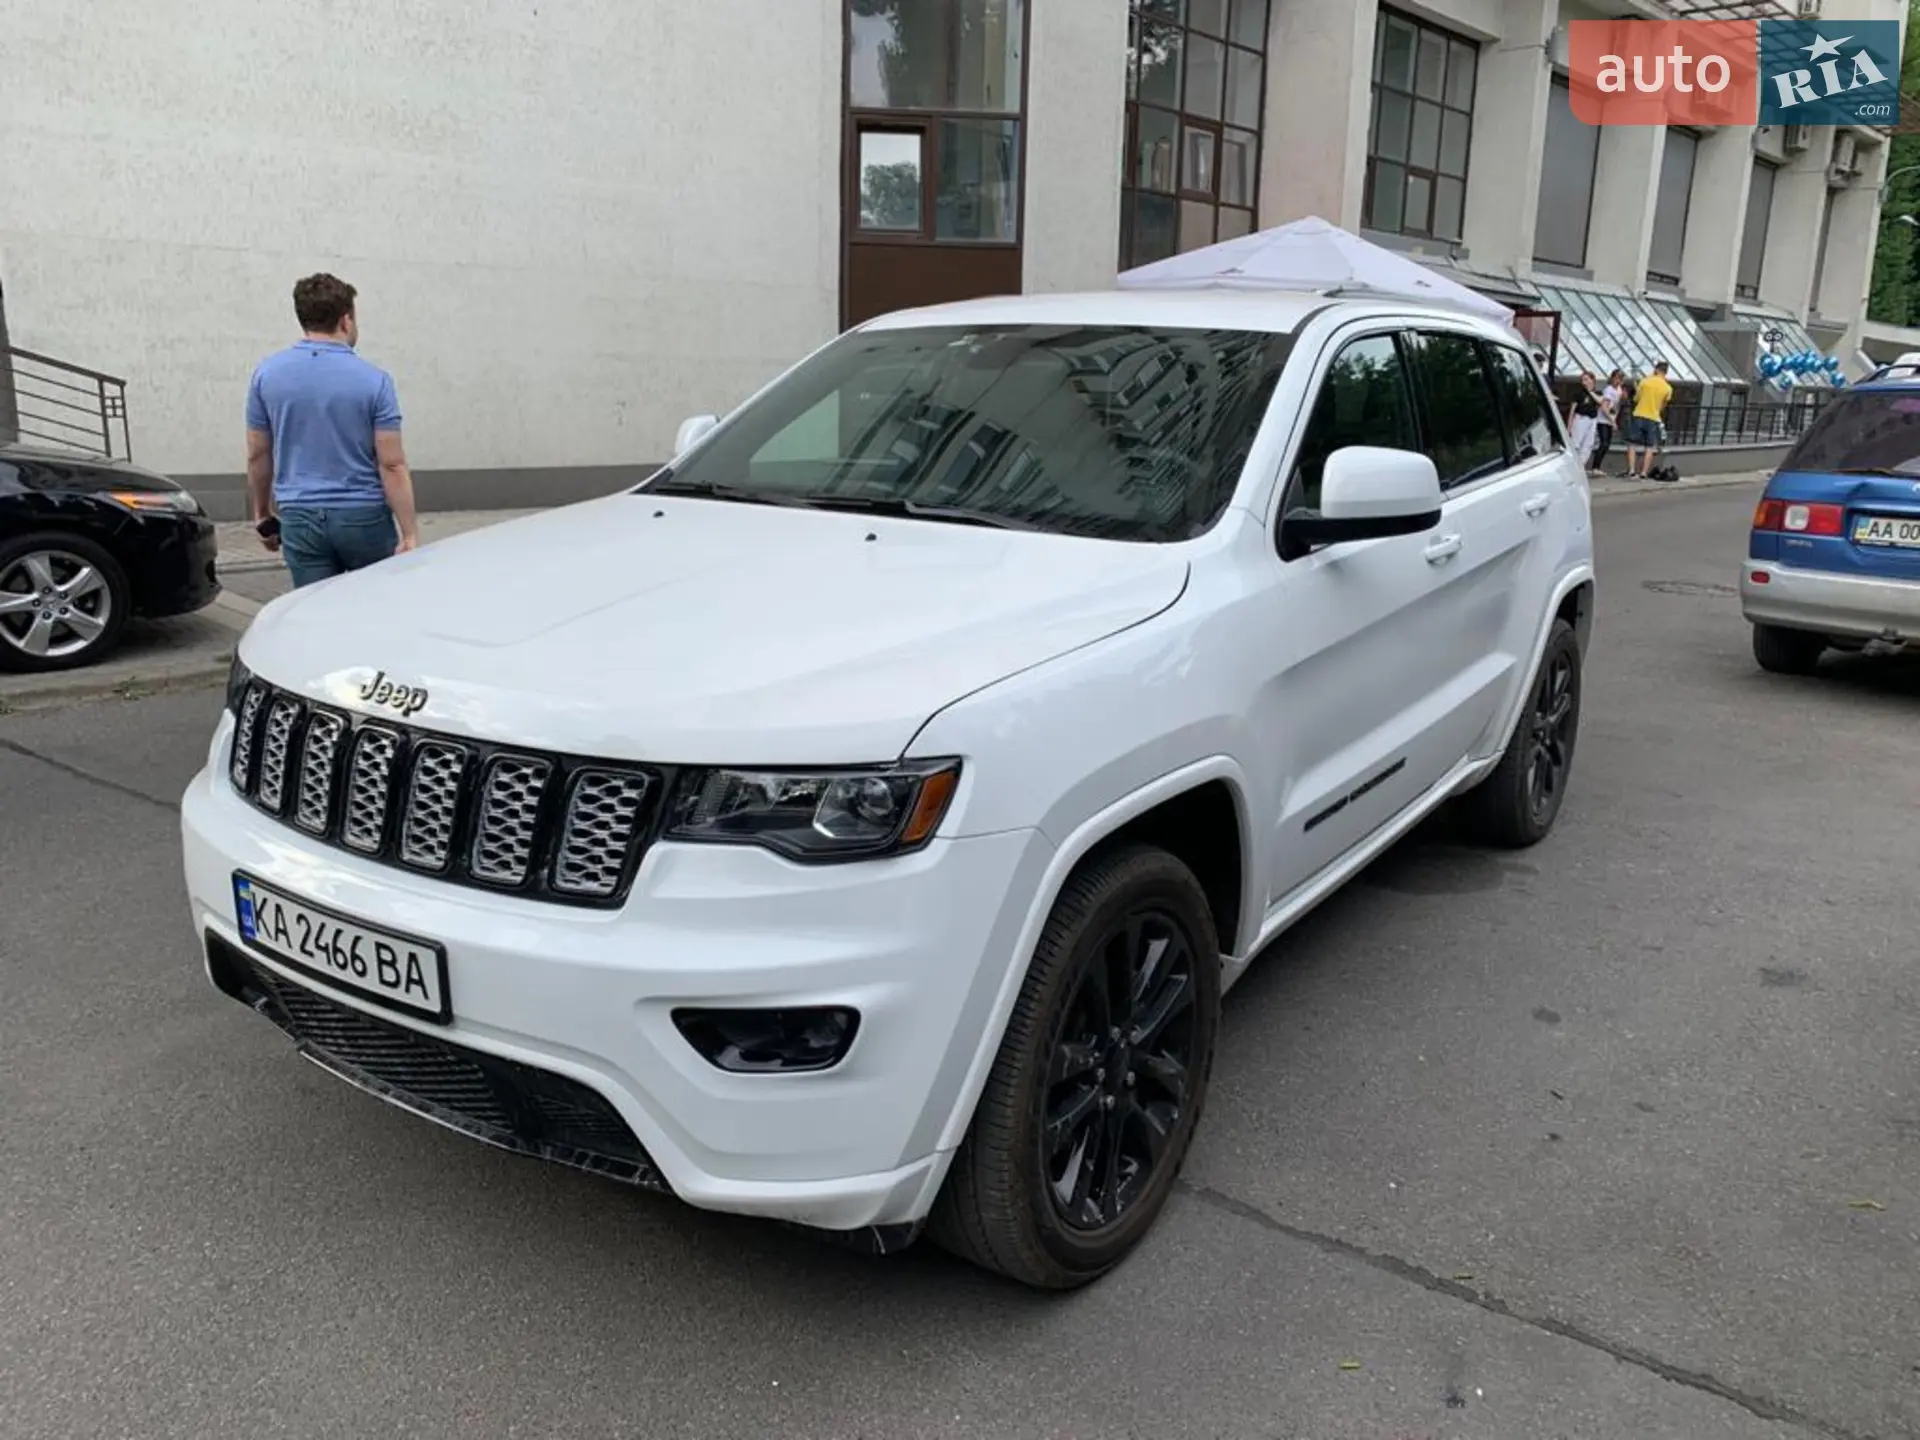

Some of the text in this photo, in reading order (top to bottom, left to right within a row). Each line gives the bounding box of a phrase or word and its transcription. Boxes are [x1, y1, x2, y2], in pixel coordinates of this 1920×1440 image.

[1868, 521, 1893, 538] AA
[360, 671, 428, 717] Jeep
[252, 892, 430, 1000] KA 2466 BA
